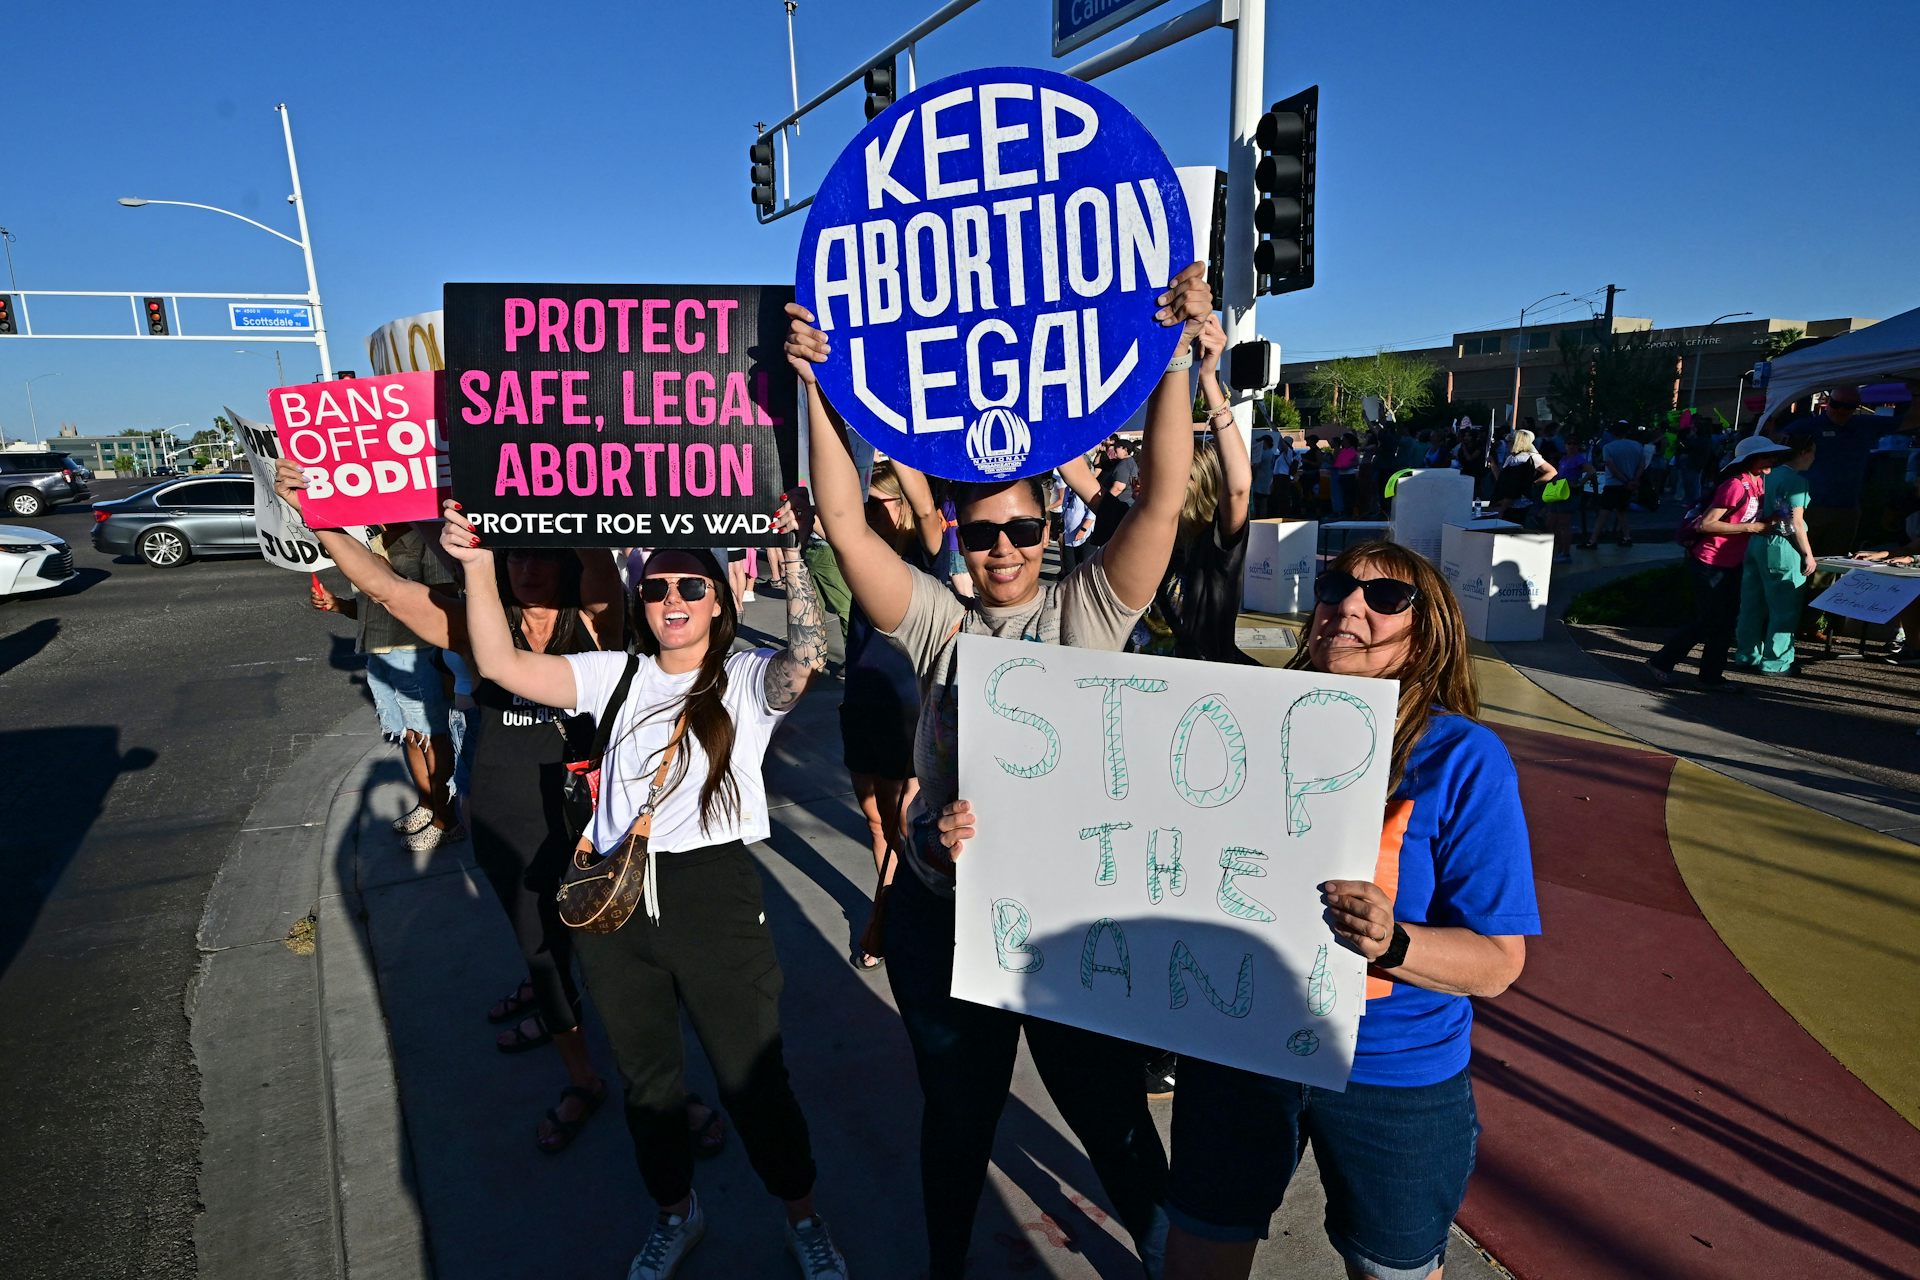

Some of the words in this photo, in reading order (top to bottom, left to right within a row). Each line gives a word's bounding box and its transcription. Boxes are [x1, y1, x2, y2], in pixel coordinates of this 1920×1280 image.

[864, 82, 1099, 210] KEEP
[814, 178, 1171, 331] ABORTION
[243, 317, 293, 327] Scottsdale
[504, 298, 739, 354] PROTECT
[849, 308, 1139, 435] LEGAL
[280, 384, 410, 428] BANS
[459, 370, 605, 432] SAFE,
[622, 371, 784, 426] LEGAL
[289, 424, 381, 465] OFF
[386, 418, 450, 456] OU
[966, 408, 1032, 459] NOW
[303, 455, 452, 500] BODIE
[495, 443, 753, 498] ABORTION
[973, 455, 1026, 465] NATIONAL
[467, 513, 588, 535] PROTECT
[596, 513, 653, 535] ROE
[660, 513, 695, 535] VS
[1498, 588, 1540, 597] SCOTTSDALE
[1844, 574, 1879, 594] Sign
[503, 710, 533, 726] OUR
[984, 657, 1377, 837] STOP
[1079, 821, 1277, 923] THE
[990, 897, 1337, 1057] BAN!
